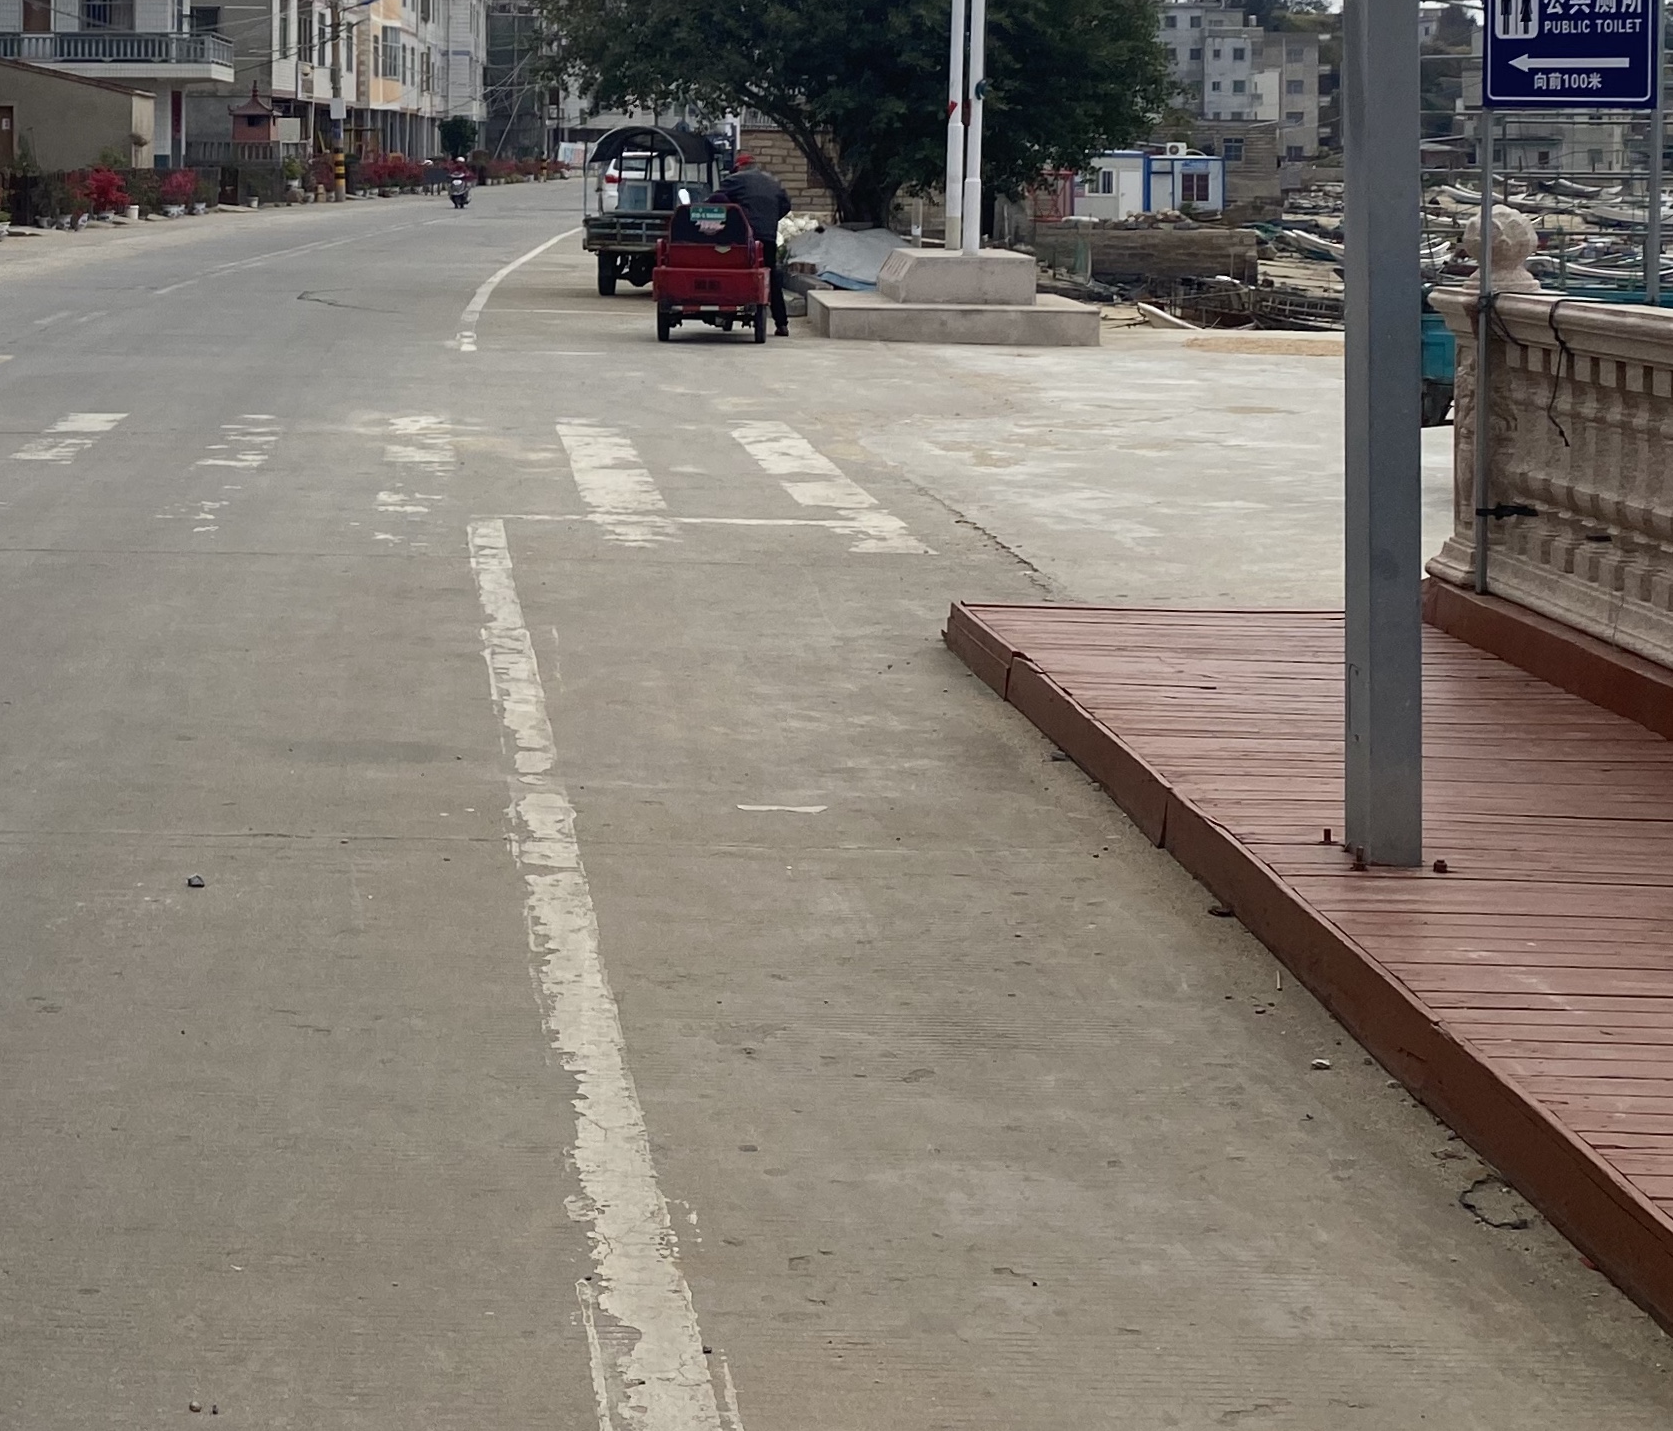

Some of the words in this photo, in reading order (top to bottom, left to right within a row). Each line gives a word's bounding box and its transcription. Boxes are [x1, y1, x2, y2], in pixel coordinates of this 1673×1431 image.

[1543, 19, 1591, 34] PUBLIC
[1595, 18, 1643, 33] TOILET
[1533, 72, 1603, 90] 向前100米
